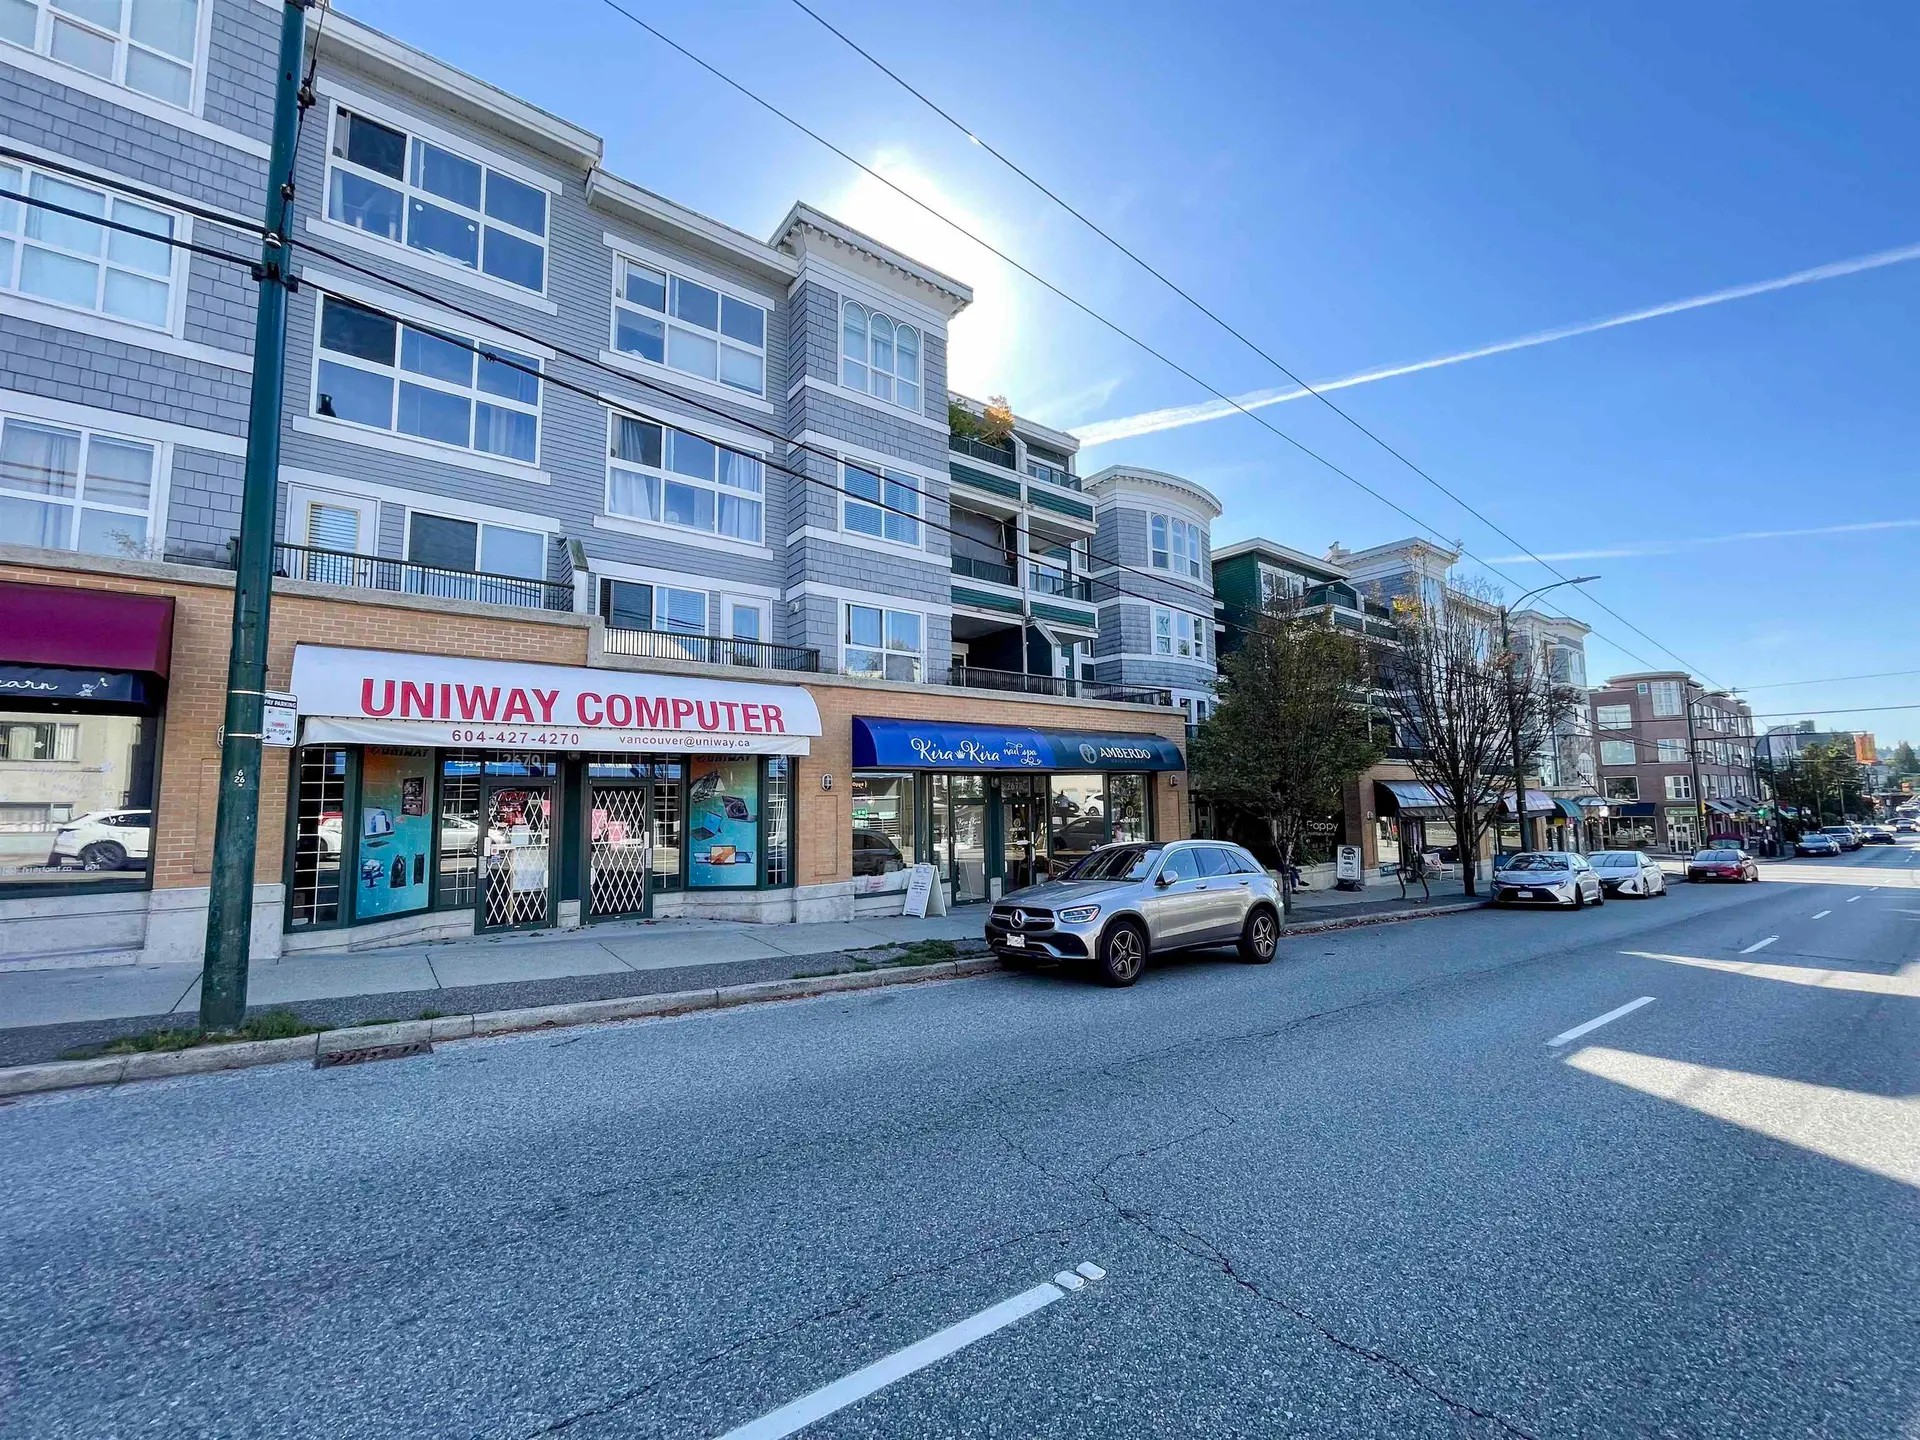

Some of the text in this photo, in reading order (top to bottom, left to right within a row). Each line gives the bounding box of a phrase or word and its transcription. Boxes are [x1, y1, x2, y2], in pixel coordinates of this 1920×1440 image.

[275, 701, 296, 709] PARKING
[361, 678, 785, 734] UNIWAY COMPUTER
[452, 729, 750, 748] 604-427-4270 vancouver@uniway.ca
[911, 737, 1042, 766] Kira Kira nail spa
[1100, 747, 1151, 759] AMBERDO
[234, 775, 245, 783] 26
[1306, 820, 1339, 832] Poppy
